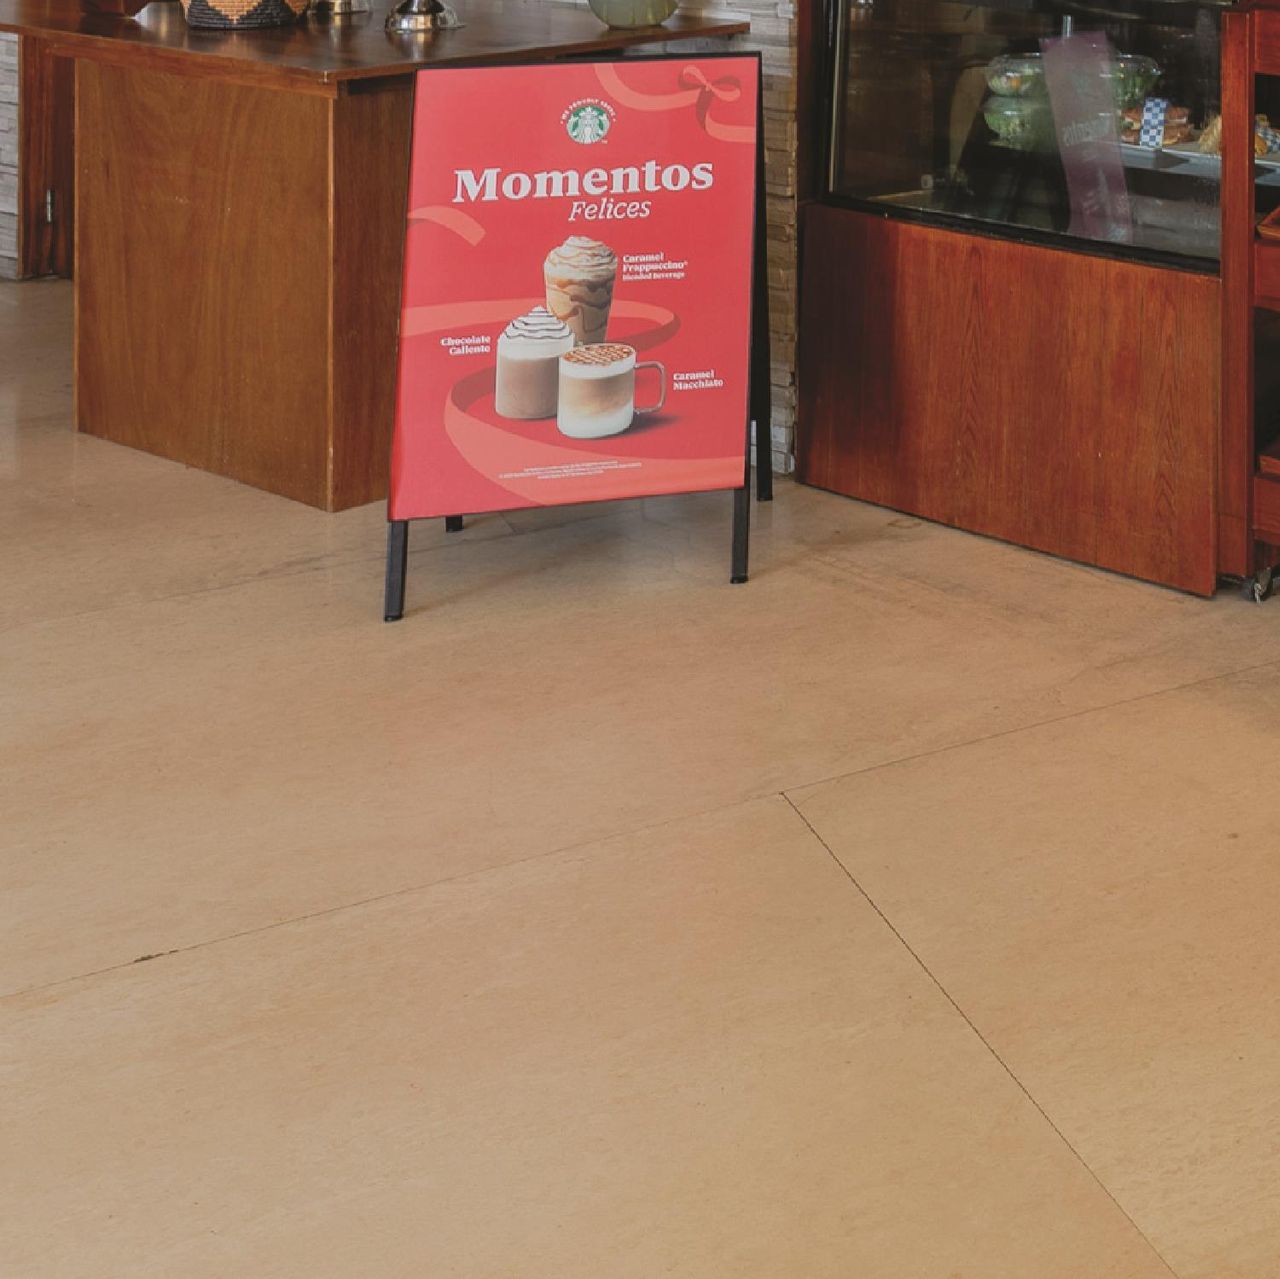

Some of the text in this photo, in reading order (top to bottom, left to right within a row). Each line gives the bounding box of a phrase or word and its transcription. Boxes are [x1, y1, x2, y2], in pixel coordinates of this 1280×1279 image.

[452, 159, 713, 203] Momentos
[568, 198, 651, 221] Felices
[623, 251, 664, 262] Caramel
[441, 336, 491, 346] Chocolate
[450, 345, 491, 355] Caliente
[673, 370, 714, 380] Caramel
[673, 379, 723, 391] Macchiato
